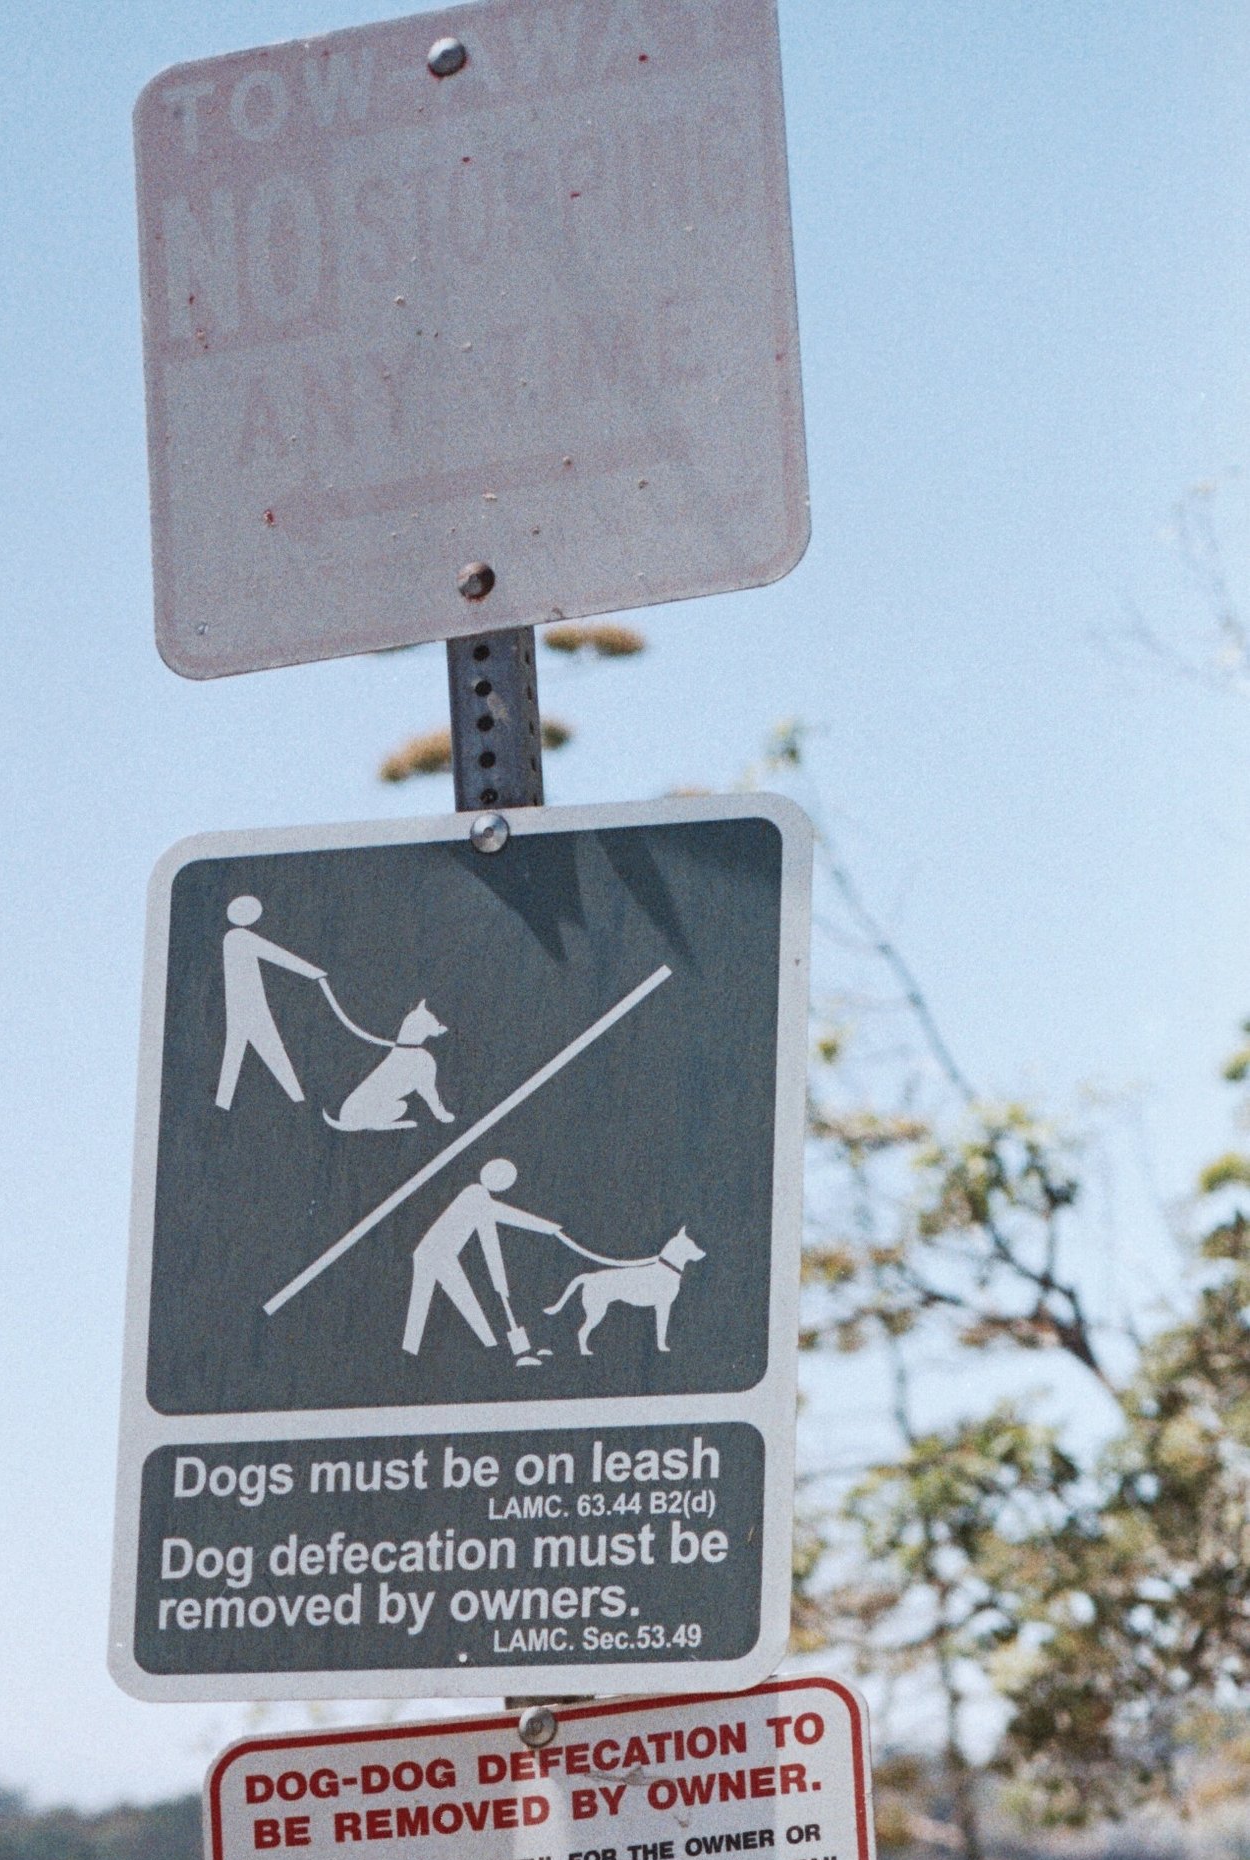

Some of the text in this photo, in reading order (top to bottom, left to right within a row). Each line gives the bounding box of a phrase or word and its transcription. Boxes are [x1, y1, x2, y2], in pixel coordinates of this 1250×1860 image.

[162, 174, 322, 341] NO
[173, 1436, 721, 1508] Dogs must be on leash
[488, 1489, 717, 1521] LAMC. 63.44 B2(d)
[161, 1519, 729, 1590] Dog defecation must be
[158, 1581, 640, 1636] removed by owners.
[493, 1623, 703, 1653] LAMC. Sec.53.49
[244, 1712, 825, 1805] DOG-DOG DEFECATION TO
[253, 1763, 821, 1851] BE REMOVED BY OWNER.
[684, 1828, 775, 1857] OWNER
[785, 1823, 821, 1845] OR
